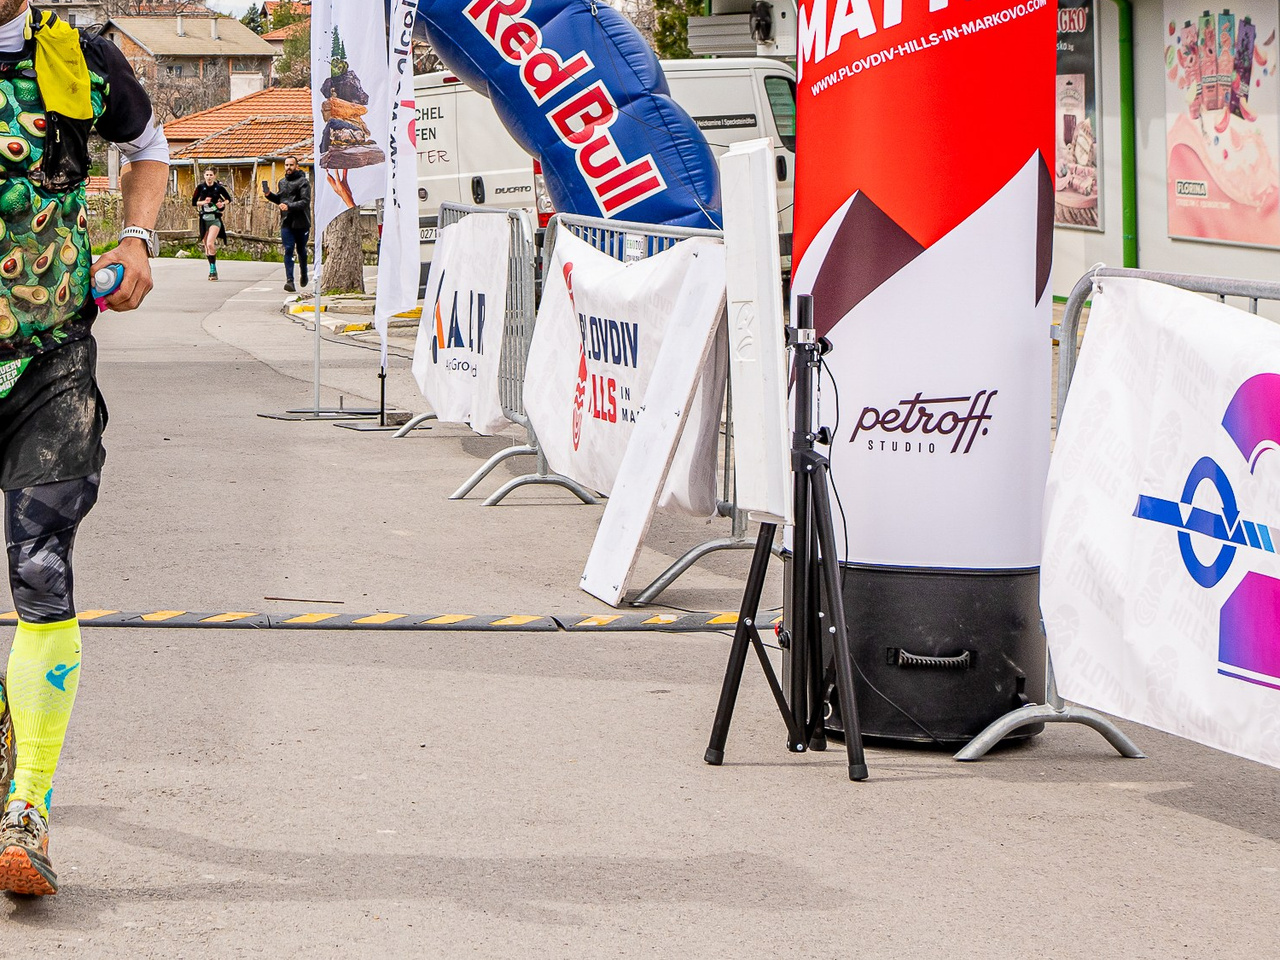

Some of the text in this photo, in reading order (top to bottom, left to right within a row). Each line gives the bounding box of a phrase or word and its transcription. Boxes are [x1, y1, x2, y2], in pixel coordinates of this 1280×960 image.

[550, 85, 662, 213] Bull
[495, 185, 532, 195] DUCATO
[620, 386, 630, 402] IN
[849, 390, 999, 455] petroff.
[867, 439, 935, 454] STUDIO
